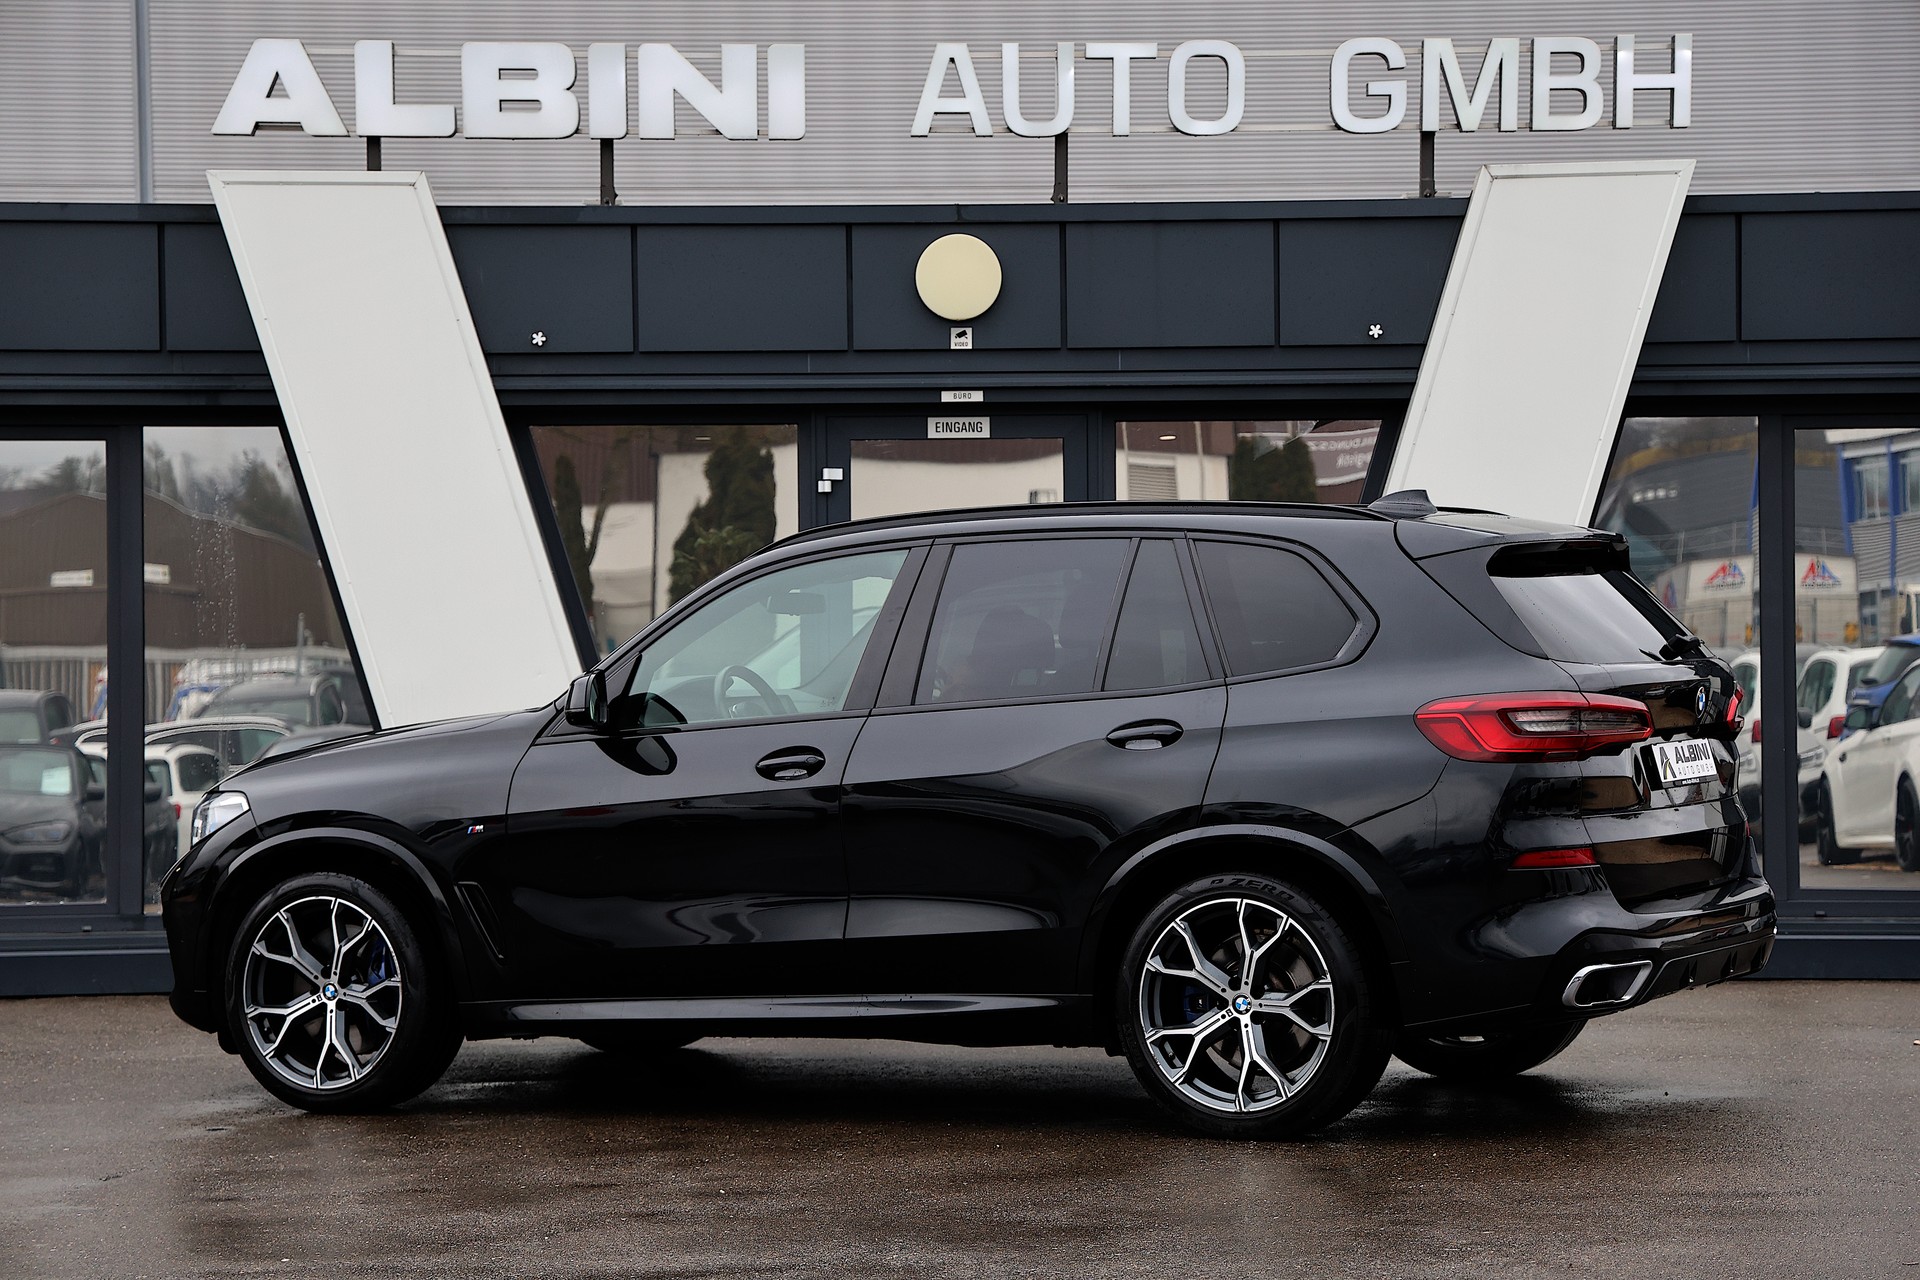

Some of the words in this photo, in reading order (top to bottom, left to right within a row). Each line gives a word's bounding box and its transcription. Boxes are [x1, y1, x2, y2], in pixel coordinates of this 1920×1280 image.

[211, 38, 806, 140] ALBINI
[910, 39, 1246, 138] AUTO
[1329, 33, 1694, 135] GMBH
[953, 391, 972, 400] BÜRO
[935, 421, 983, 433] EINGANG
[1674, 742, 1711, 764] ALBINI
